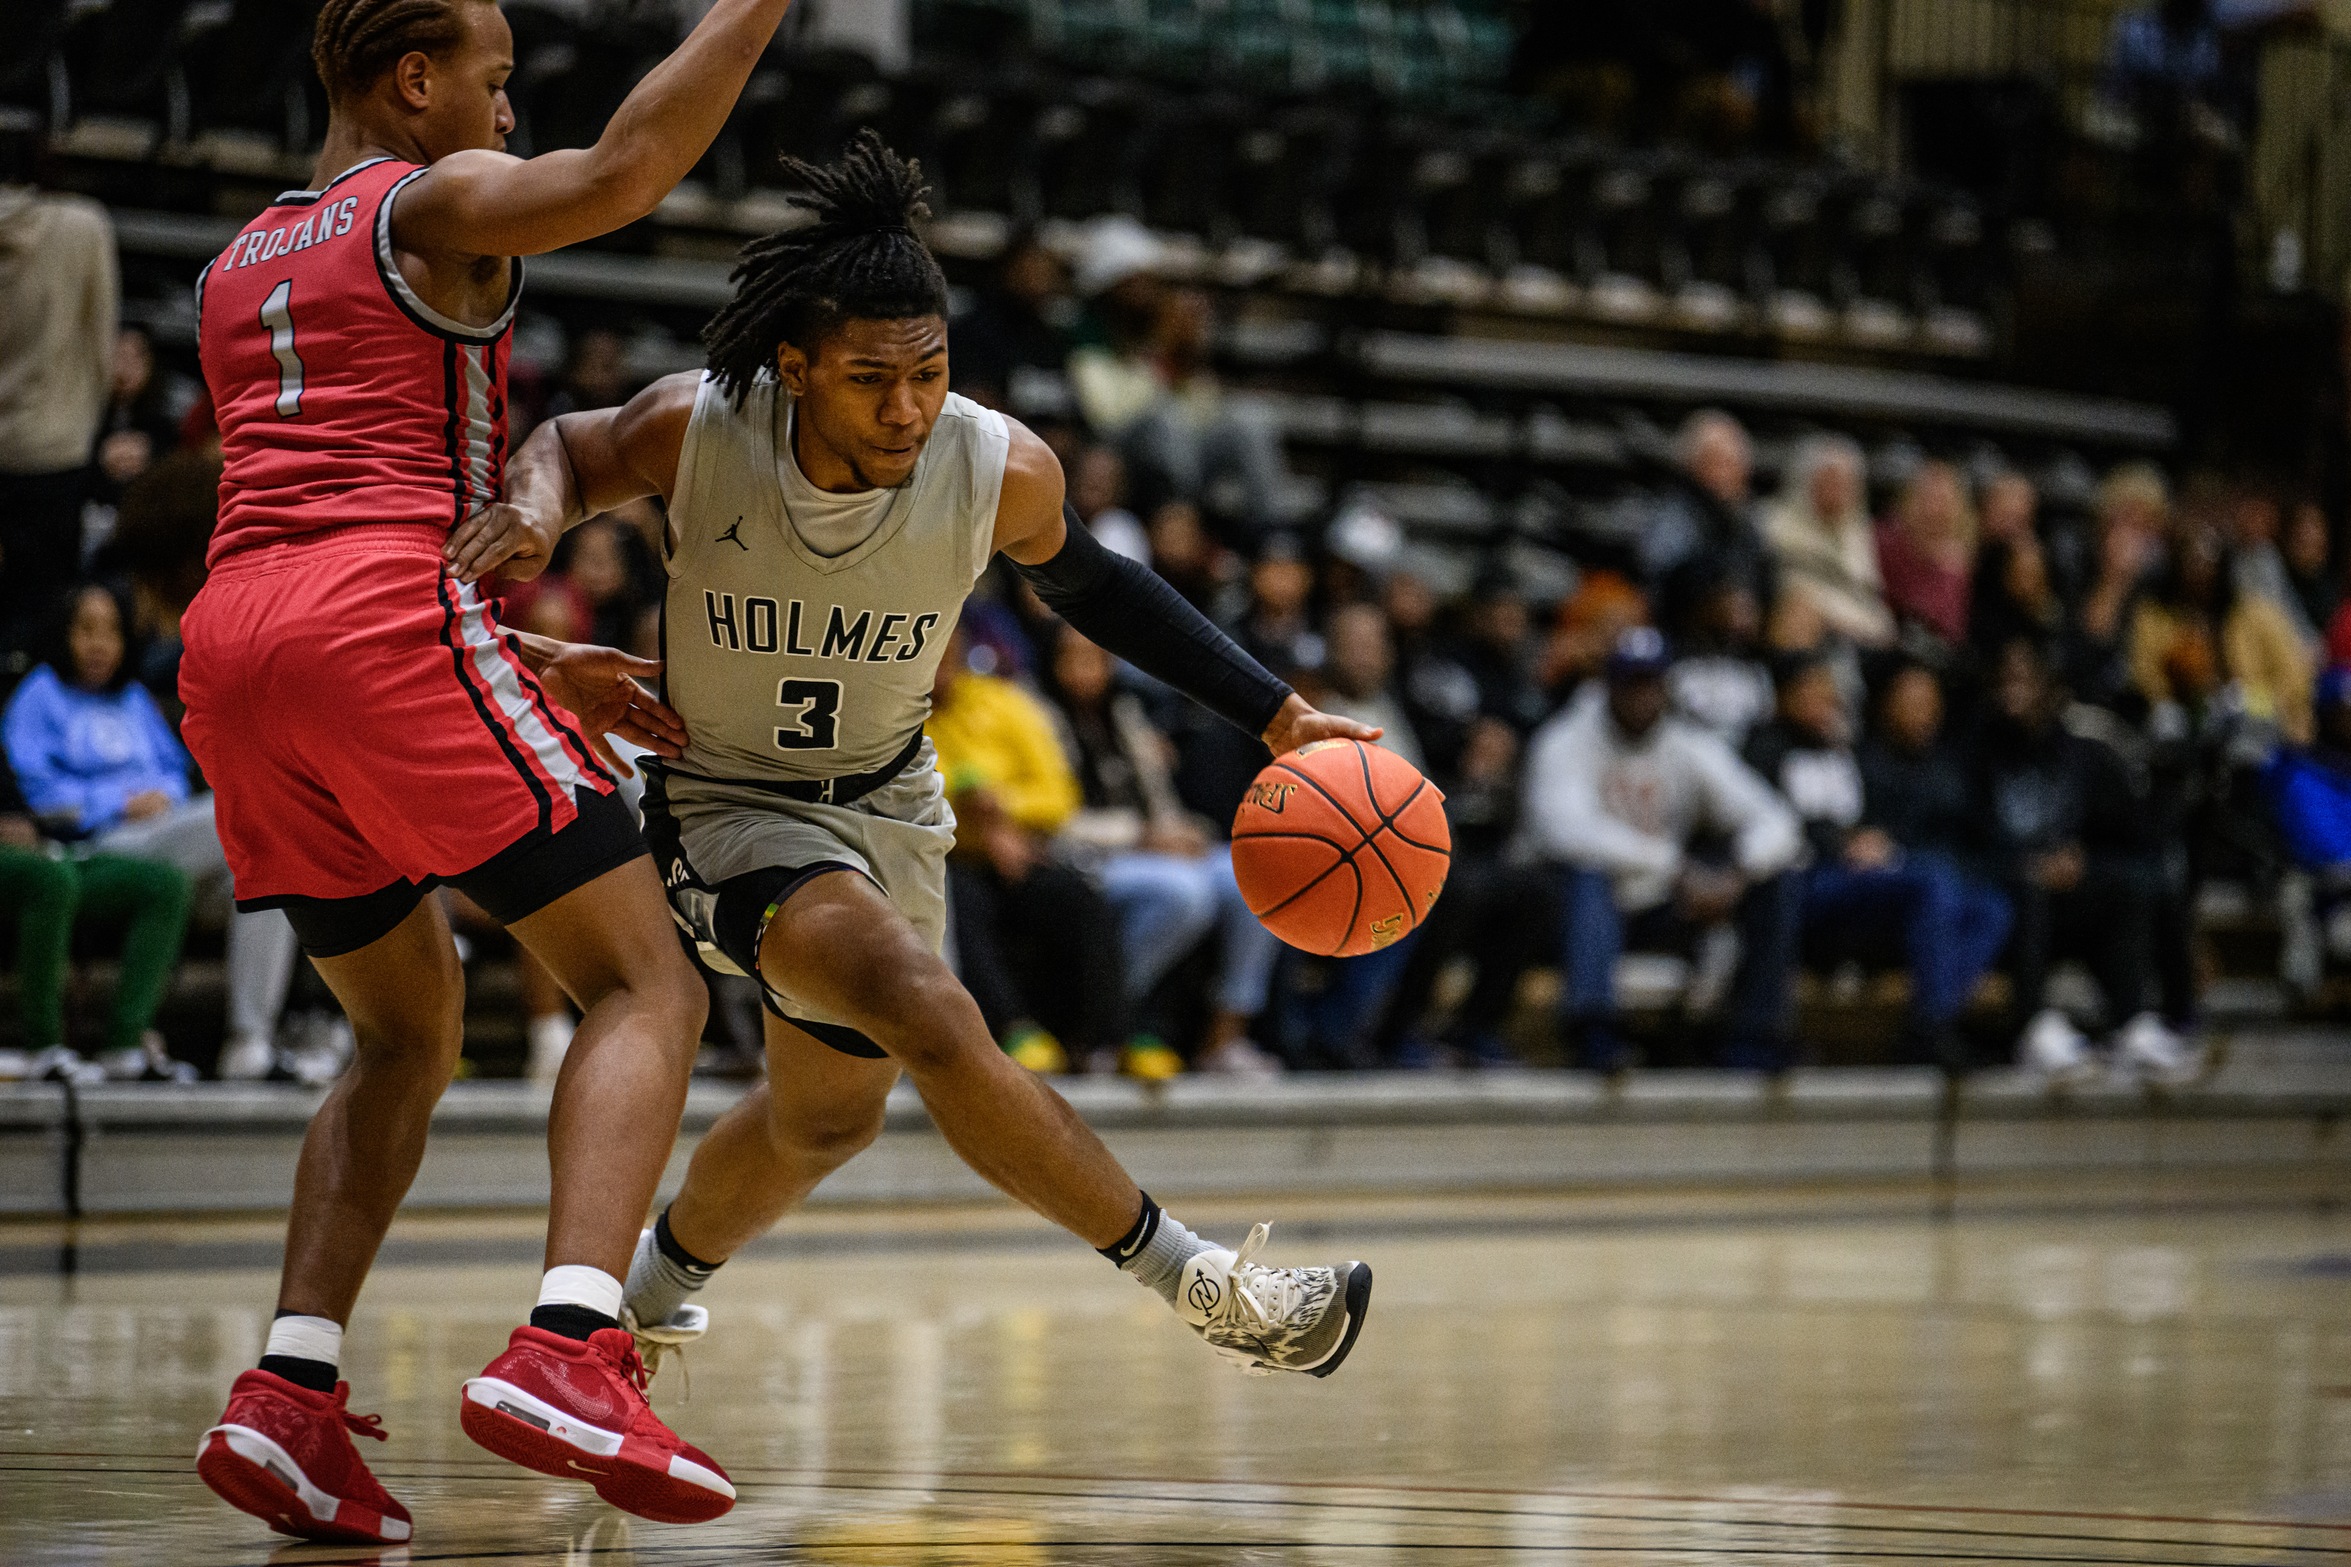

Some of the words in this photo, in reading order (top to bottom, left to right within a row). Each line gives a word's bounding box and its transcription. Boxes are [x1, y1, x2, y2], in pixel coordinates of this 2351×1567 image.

[223, 196, 359, 272] TROJANS
[259, 278, 305, 419] 1
[703, 588, 941, 664] HOLMES
[773, 676, 844, 752] 3
